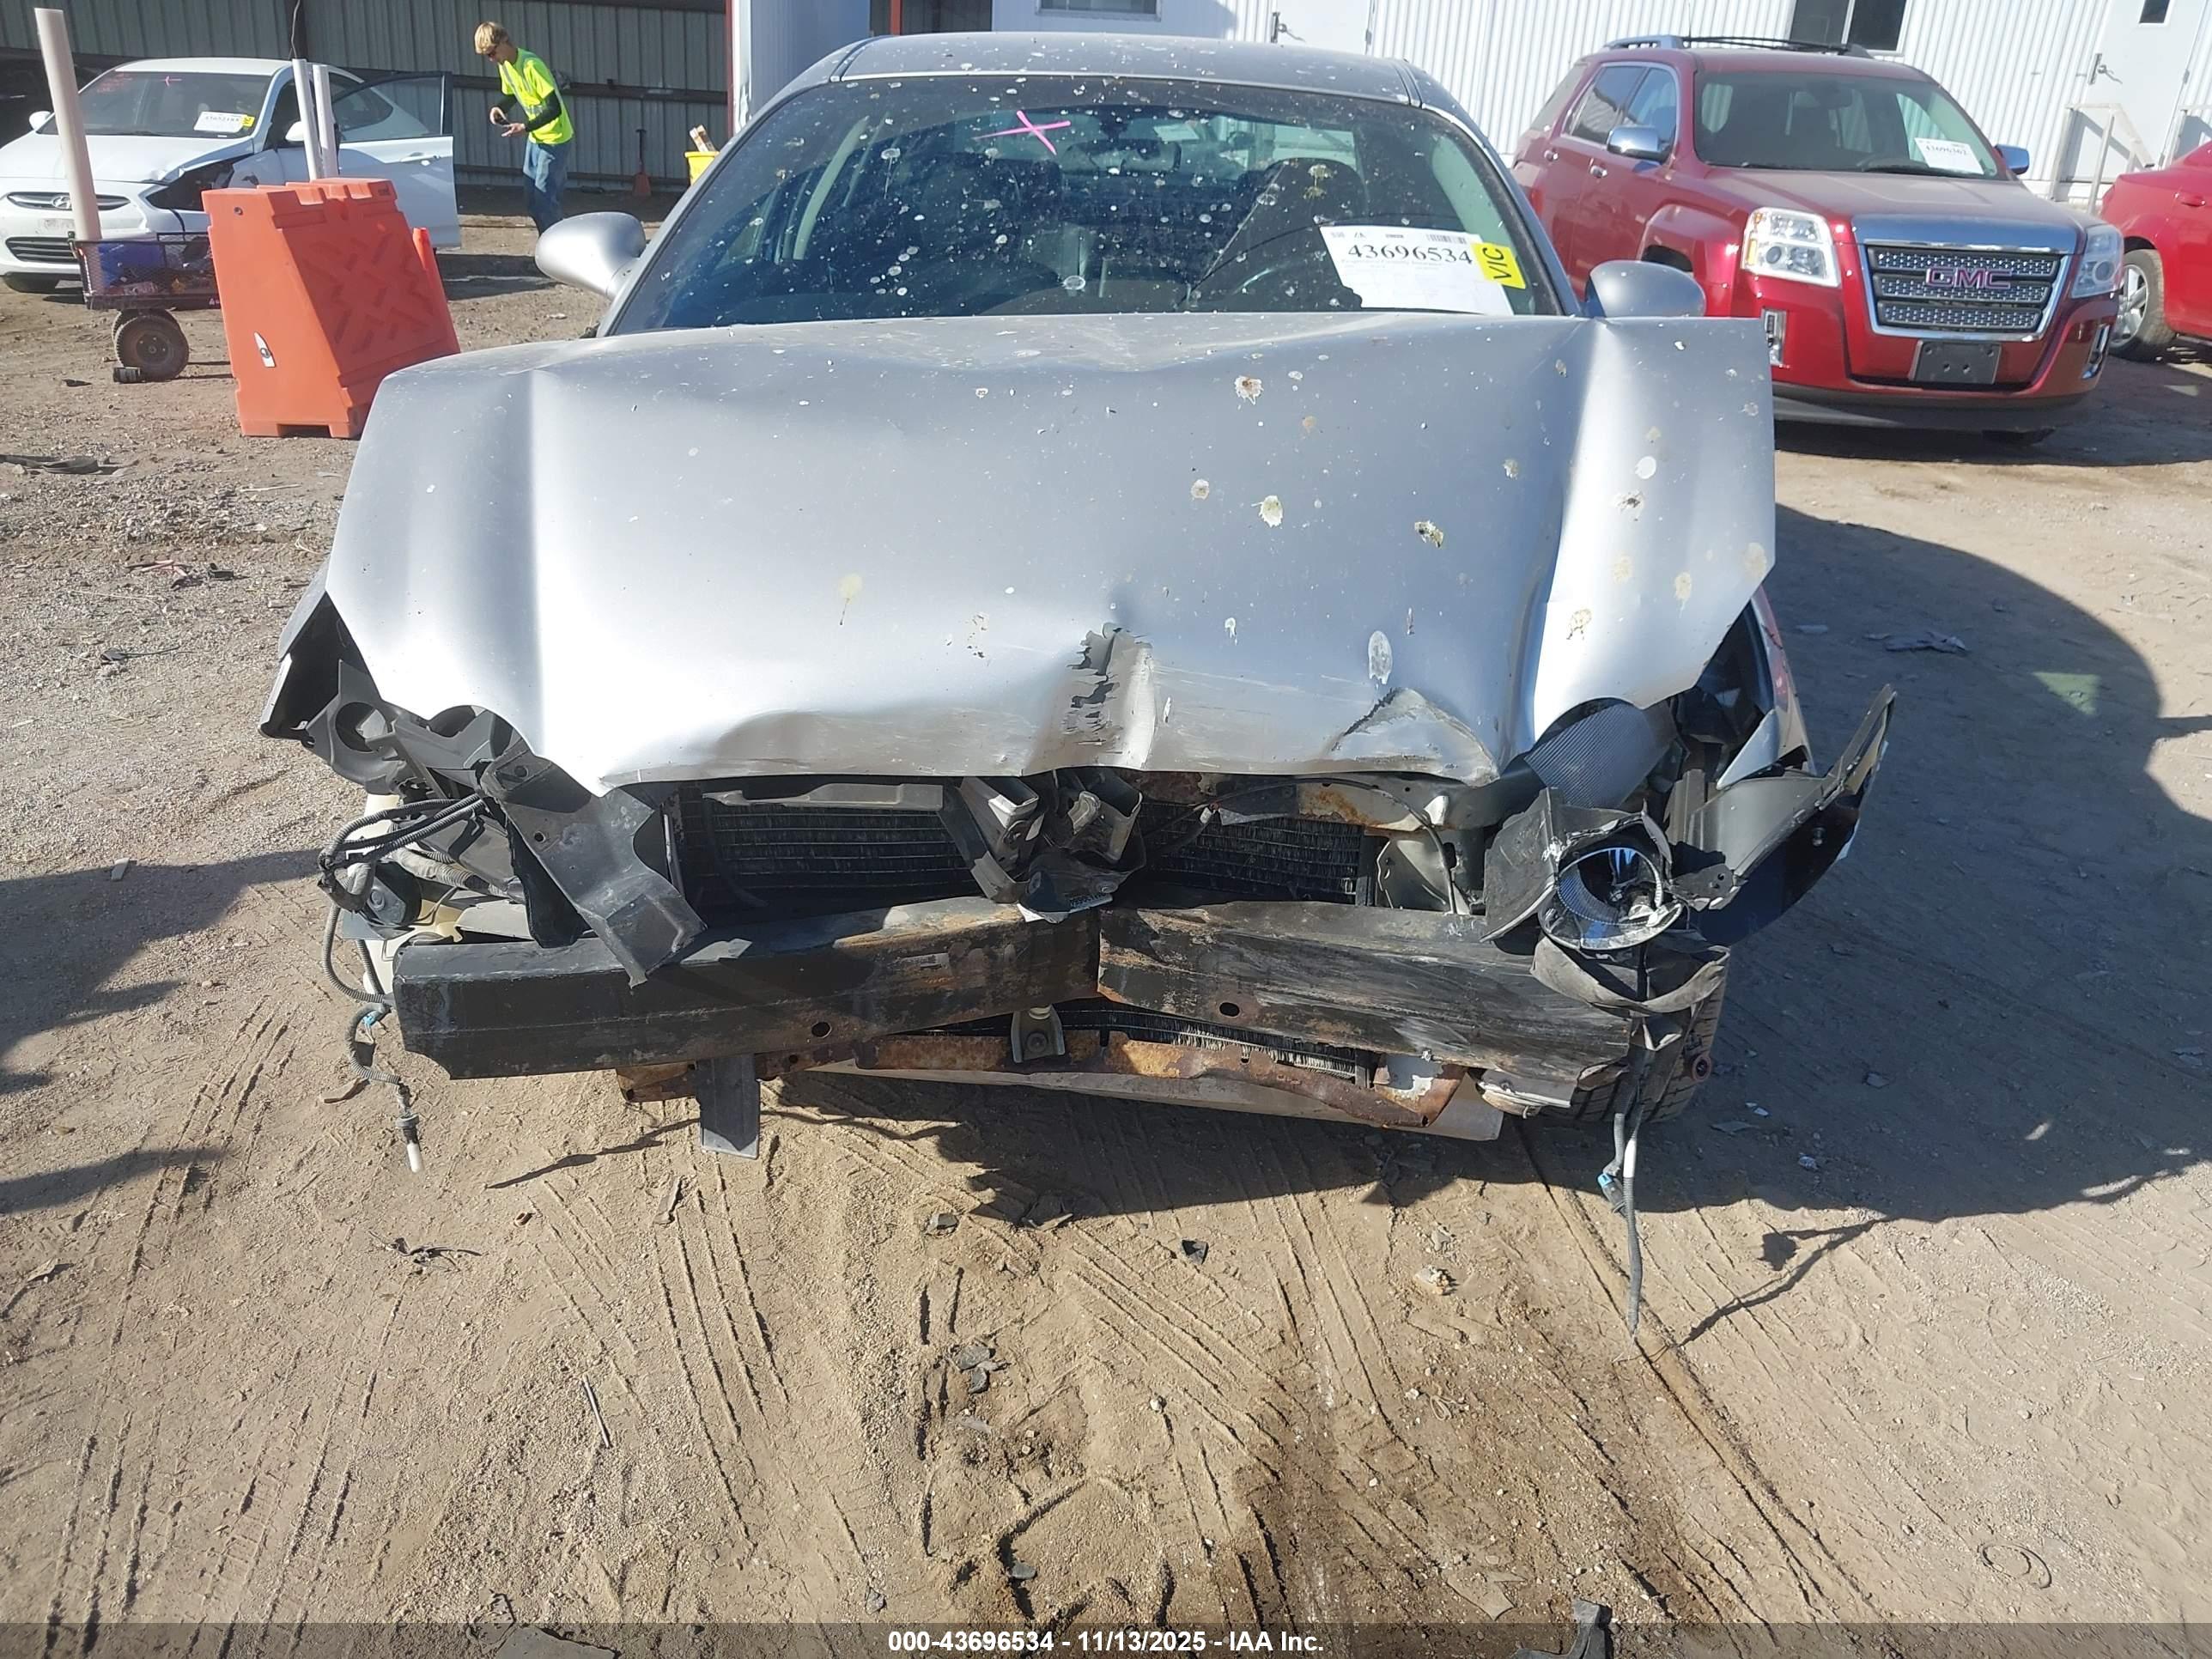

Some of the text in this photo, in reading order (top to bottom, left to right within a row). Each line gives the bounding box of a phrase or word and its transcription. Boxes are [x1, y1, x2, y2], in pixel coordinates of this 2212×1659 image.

[1348, 244, 1473, 264] 43696534
[1482, 247, 1512, 279] VIC
[1926, 267, 2013, 289] GMC
